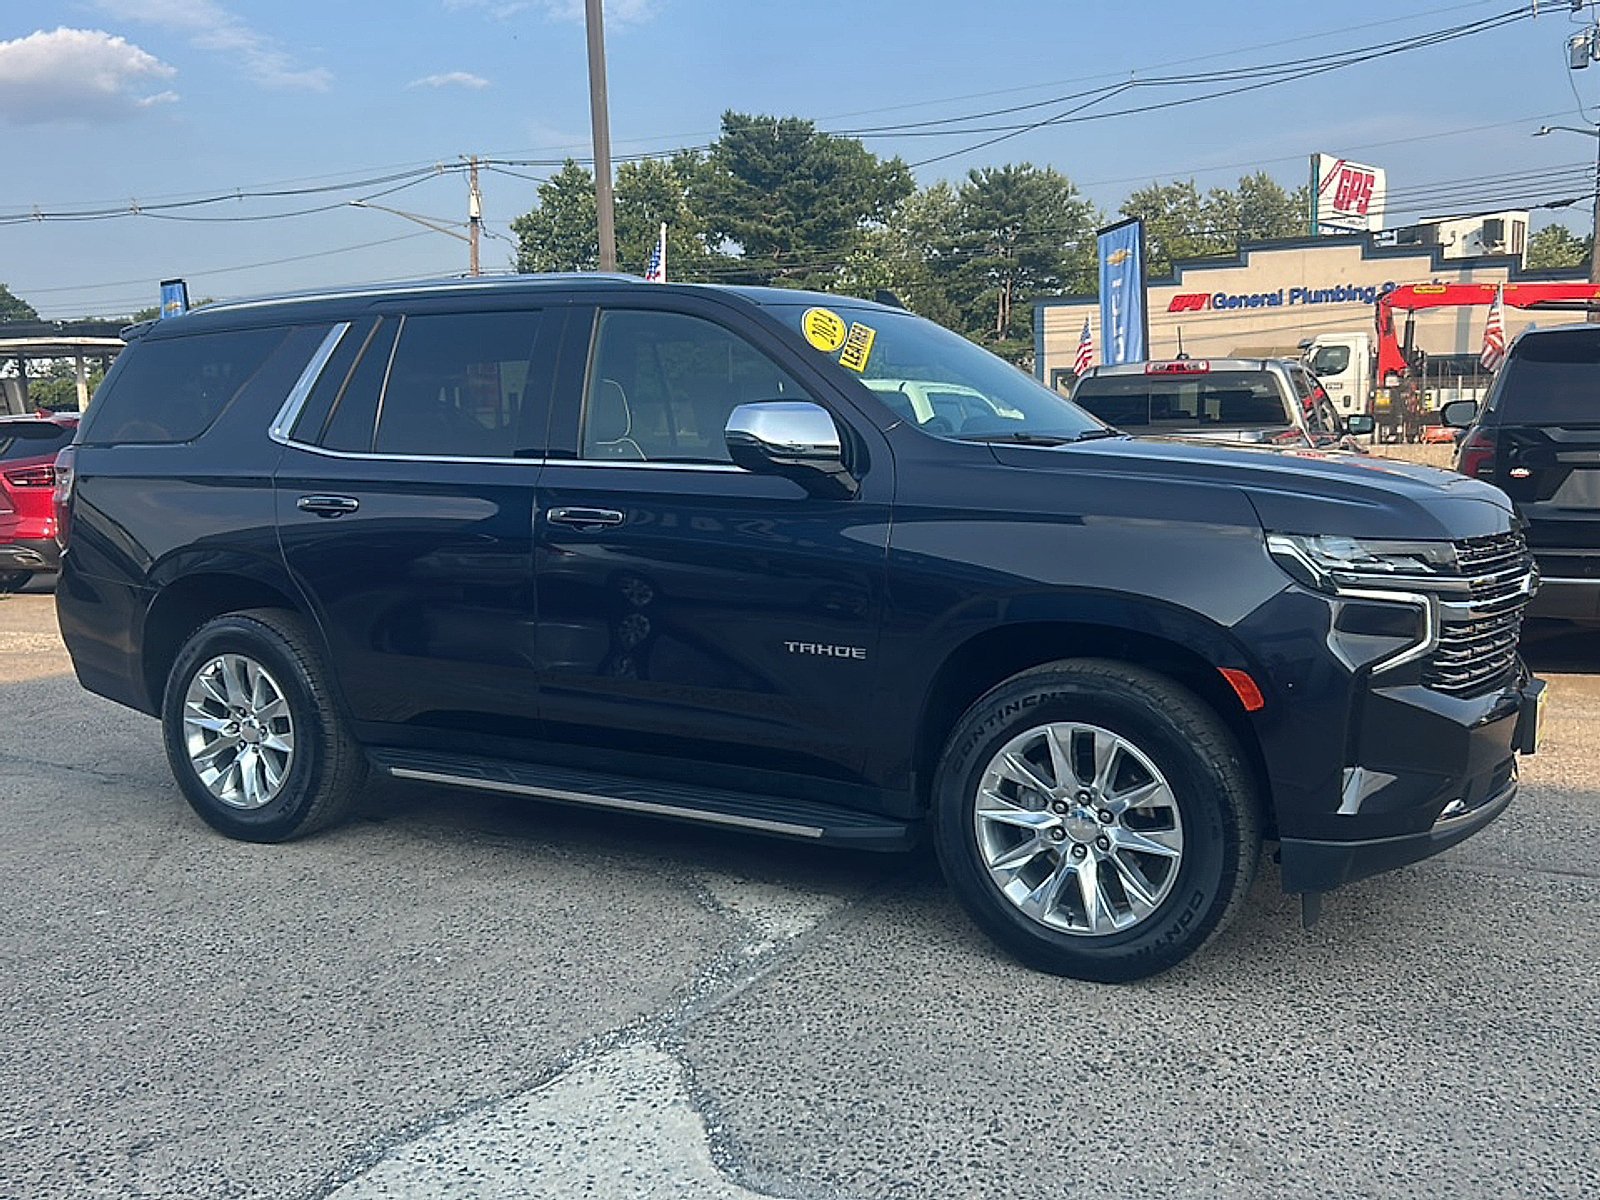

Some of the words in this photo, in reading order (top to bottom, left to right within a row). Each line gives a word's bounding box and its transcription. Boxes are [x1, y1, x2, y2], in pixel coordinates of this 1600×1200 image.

[1333, 169, 1375, 216] GPS
[1212, 290, 1283, 309] General
[1289, 284, 1376, 304] Plumbing
[842, 324, 873, 367] LEATHER
[784, 641, 867, 660] TAHOE
